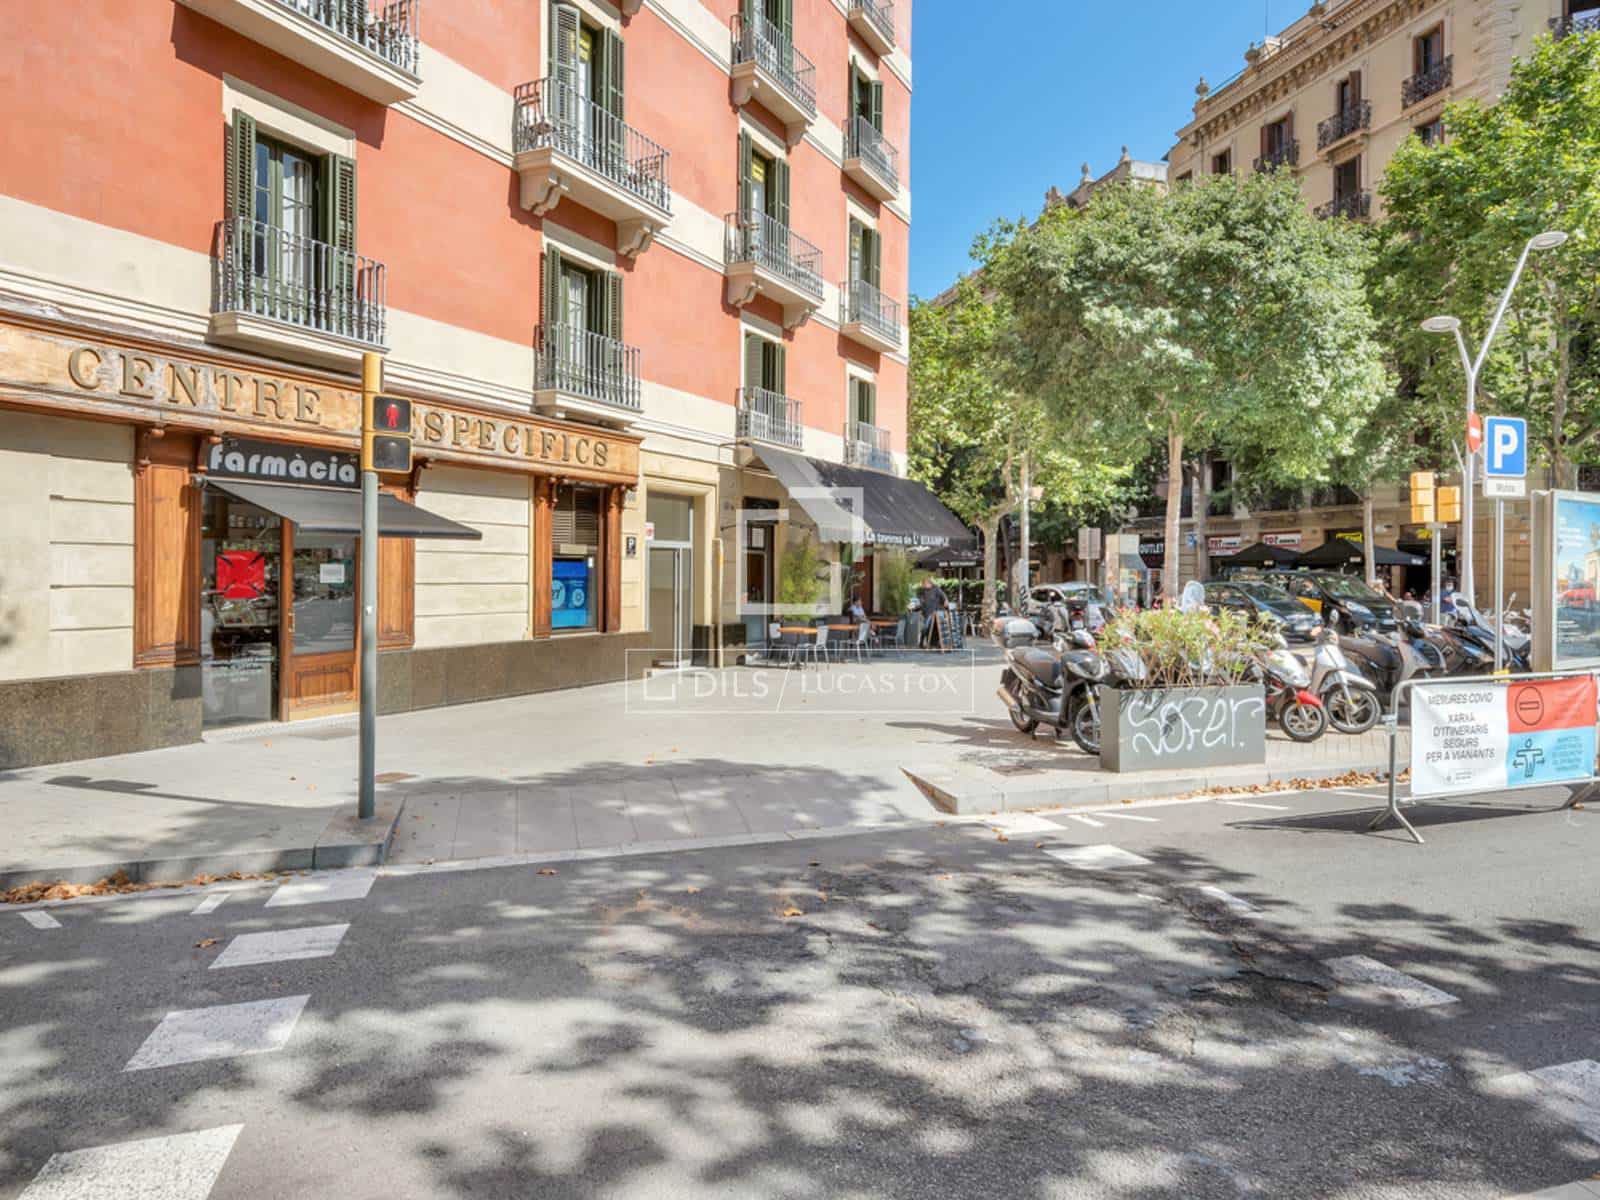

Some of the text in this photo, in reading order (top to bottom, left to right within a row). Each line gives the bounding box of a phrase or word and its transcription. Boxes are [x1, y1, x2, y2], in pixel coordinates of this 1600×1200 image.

[68, 348, 321, 424] CENTRE
[411, 406, 609, 467] SPECIFICS
[1494, 425, 1518, 469] P
[209, 444, 356, 483] farmàcia
[1469, 692, 1493, 703] COVID
[1443, 737, 1479, 749] SEGURS
